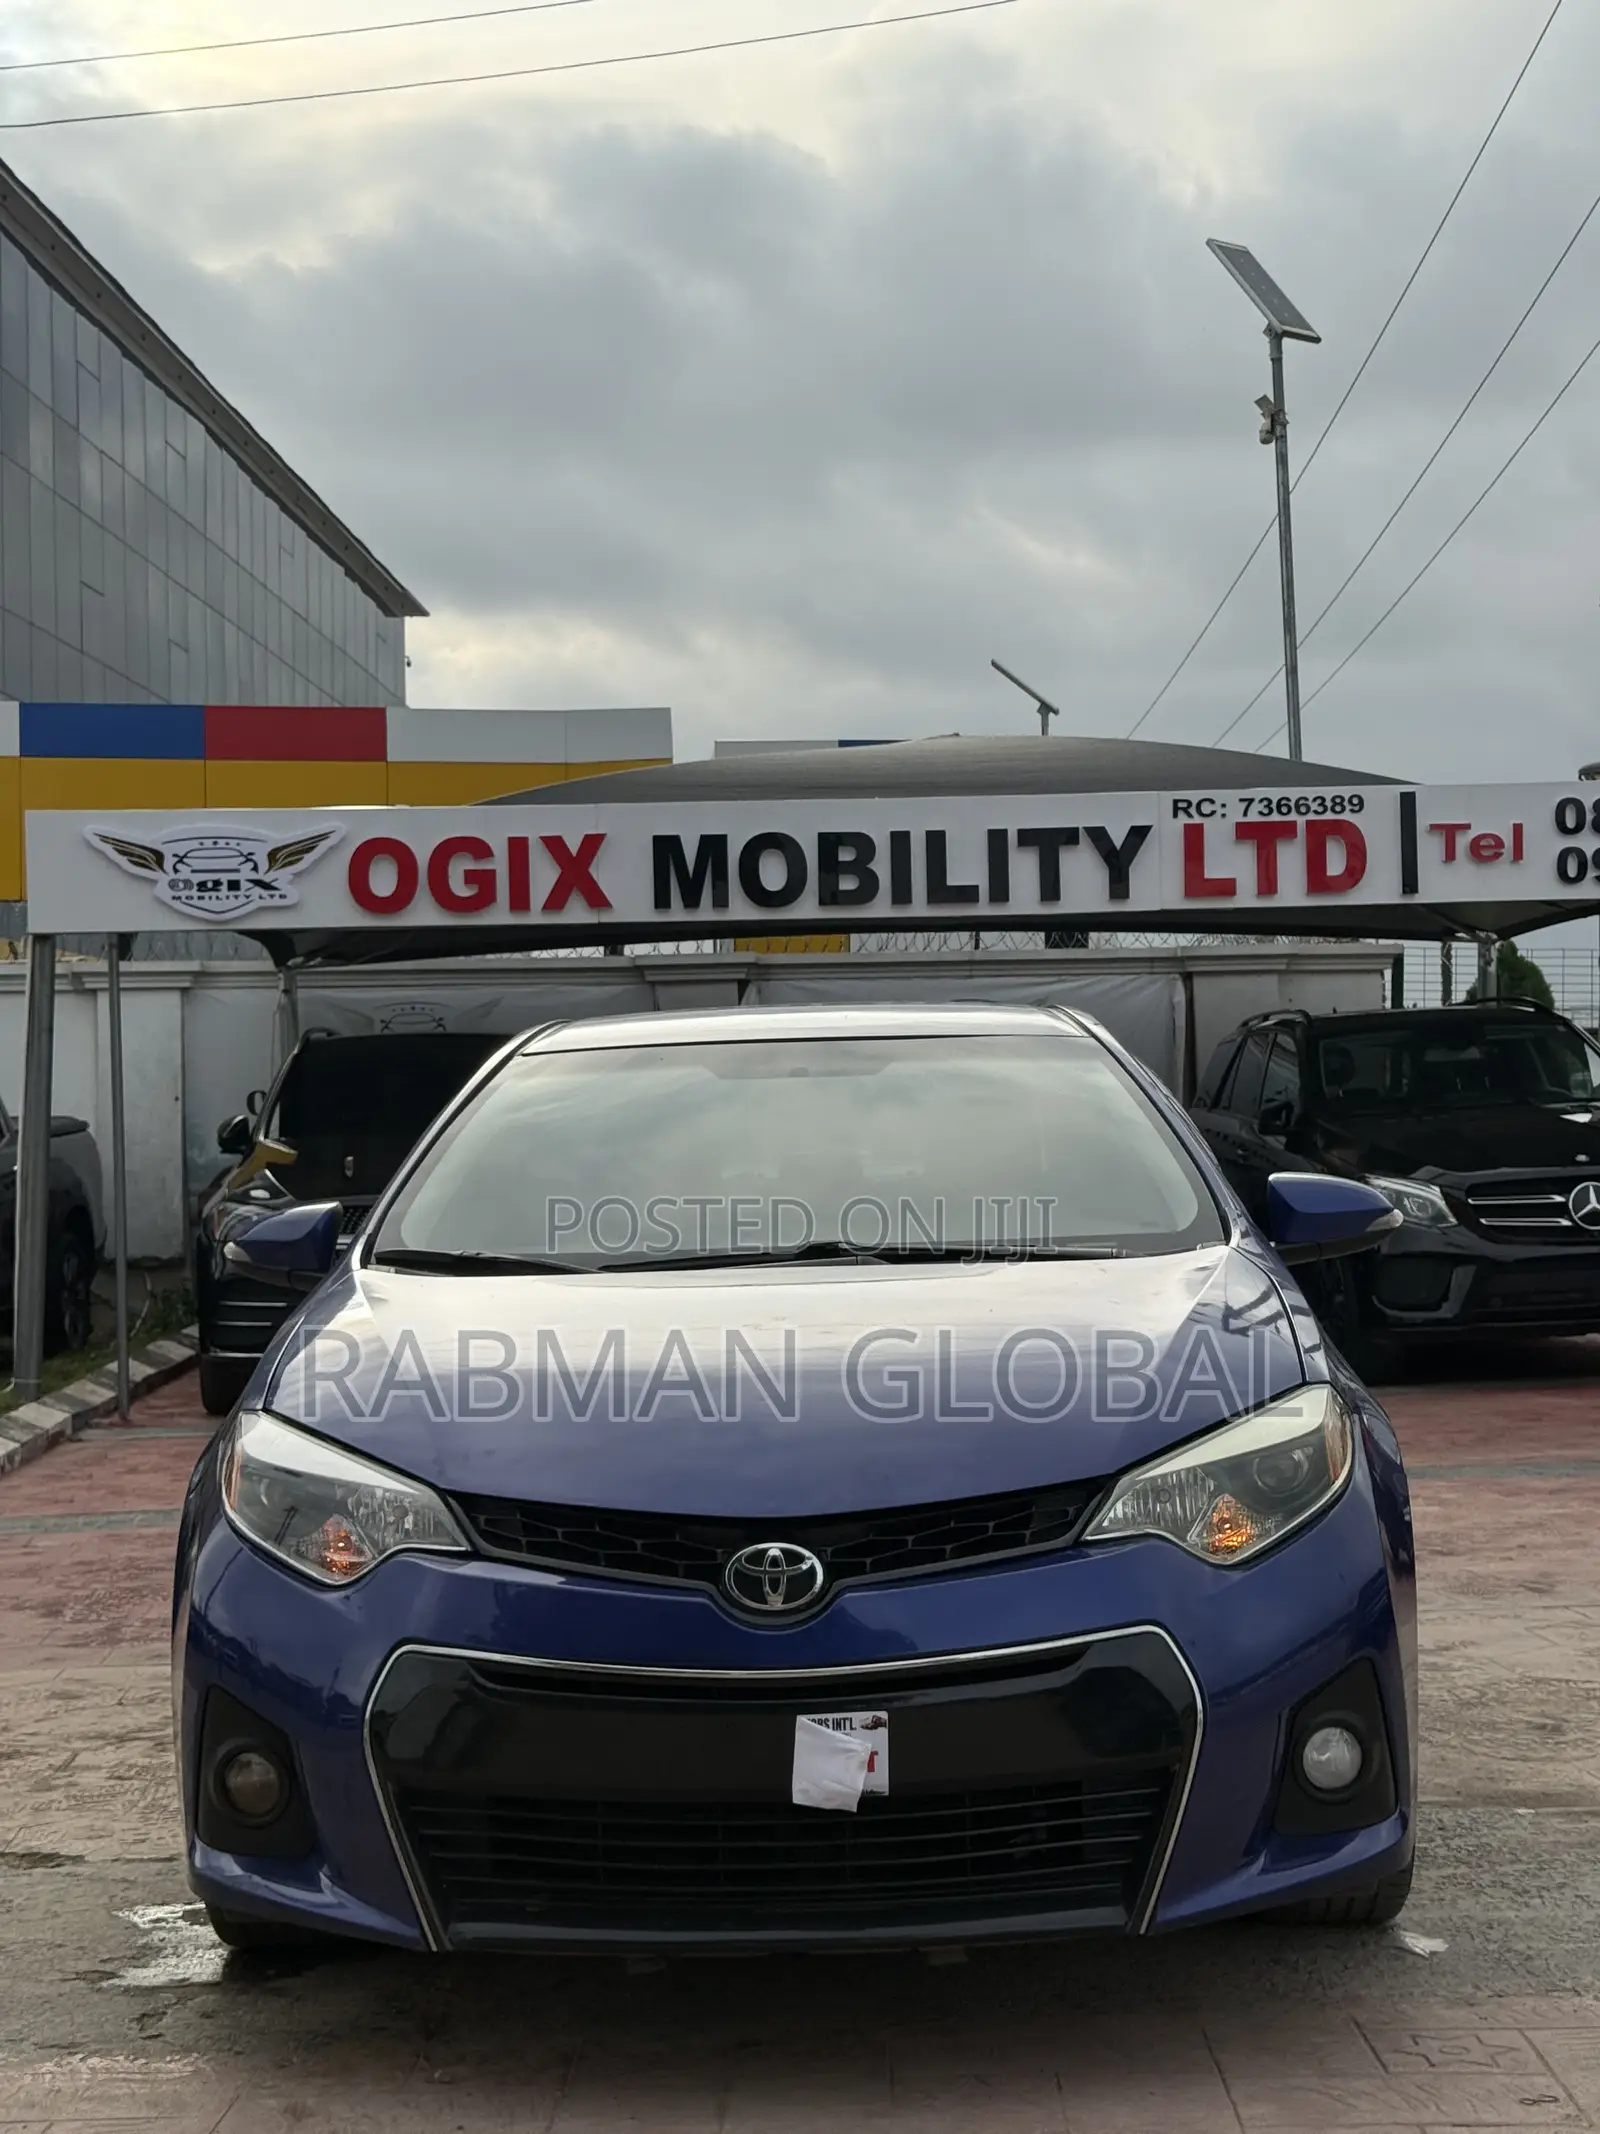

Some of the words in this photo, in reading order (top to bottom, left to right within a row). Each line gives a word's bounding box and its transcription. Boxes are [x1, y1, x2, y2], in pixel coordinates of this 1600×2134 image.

[1171, 799, 1227, 819] RC:
[1238, 793, 1365, 817] 7366389
[1555, 797, 1600, 835] 0
[1428, 822, 1524, 863] Tel
[348, 833, 613, 915] OGIX
[652, 825, 1153, 910] MOBILITY
[1183, 818, 1367, 898] LTD
[258, 892, 288, 900] LTD
